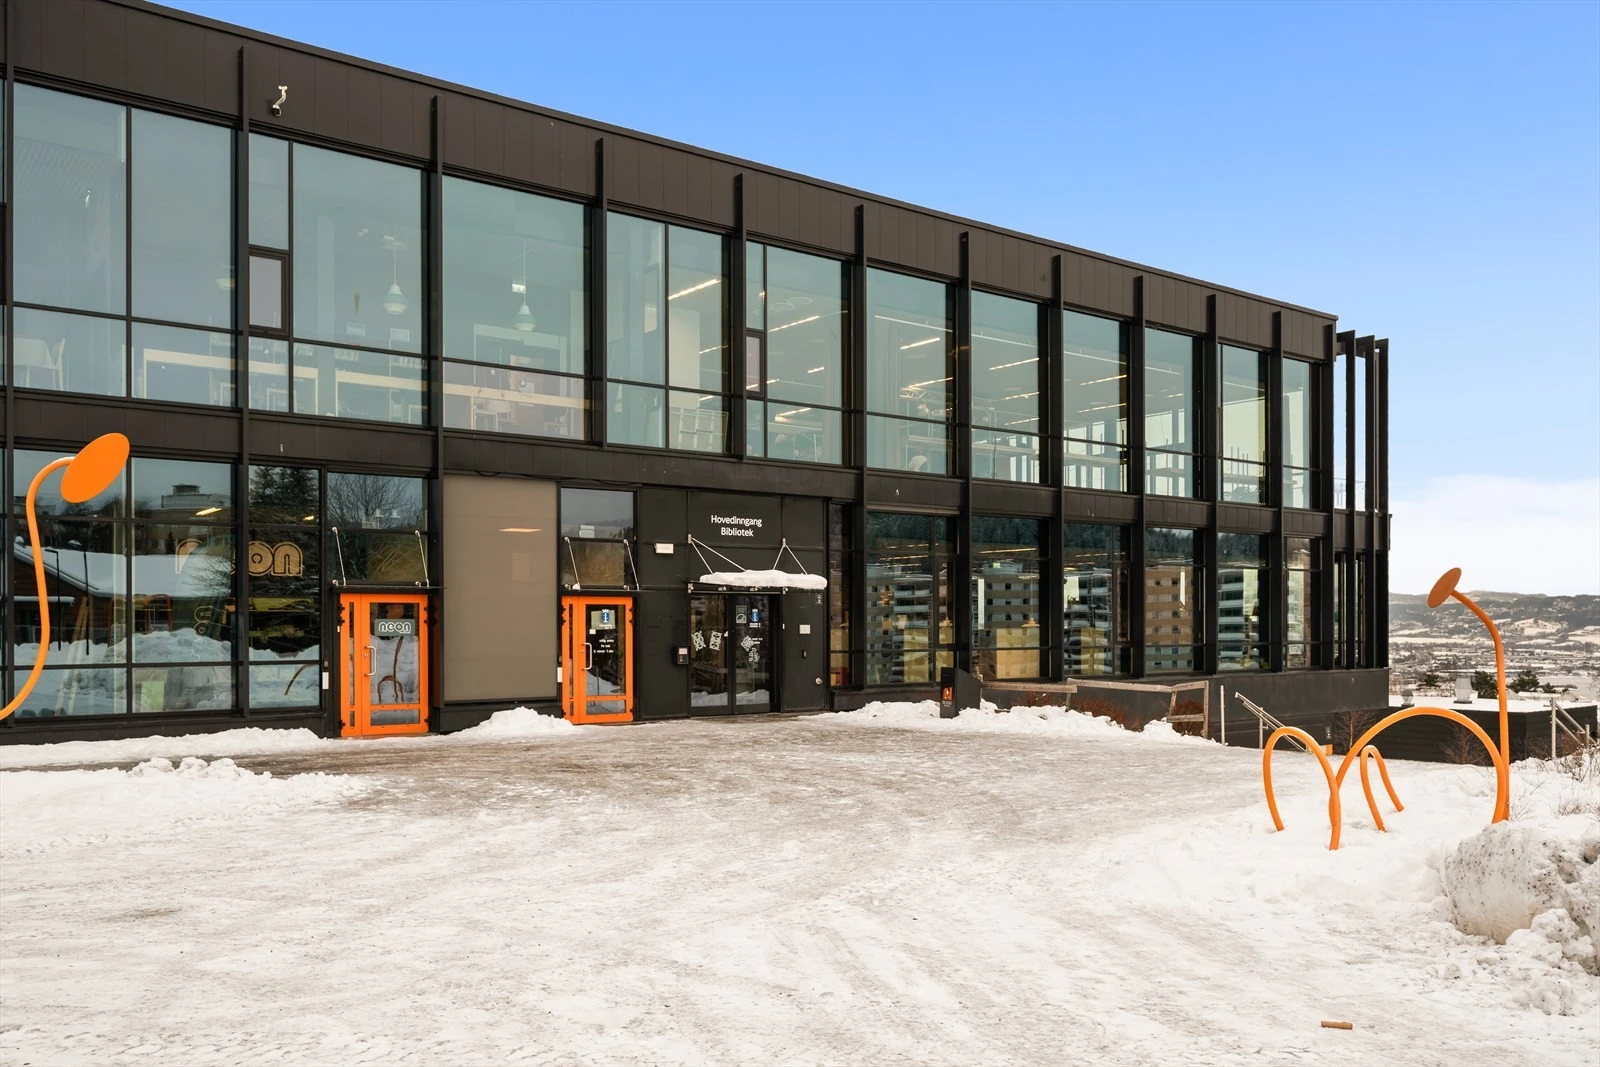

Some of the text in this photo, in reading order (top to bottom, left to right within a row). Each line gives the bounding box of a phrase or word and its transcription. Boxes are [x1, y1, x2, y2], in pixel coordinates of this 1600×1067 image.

[711, 514, 763, 528] Hovedinngang
[720, 527, 754, 537] Bibliotek
[378, 621, 412, 633] neon
